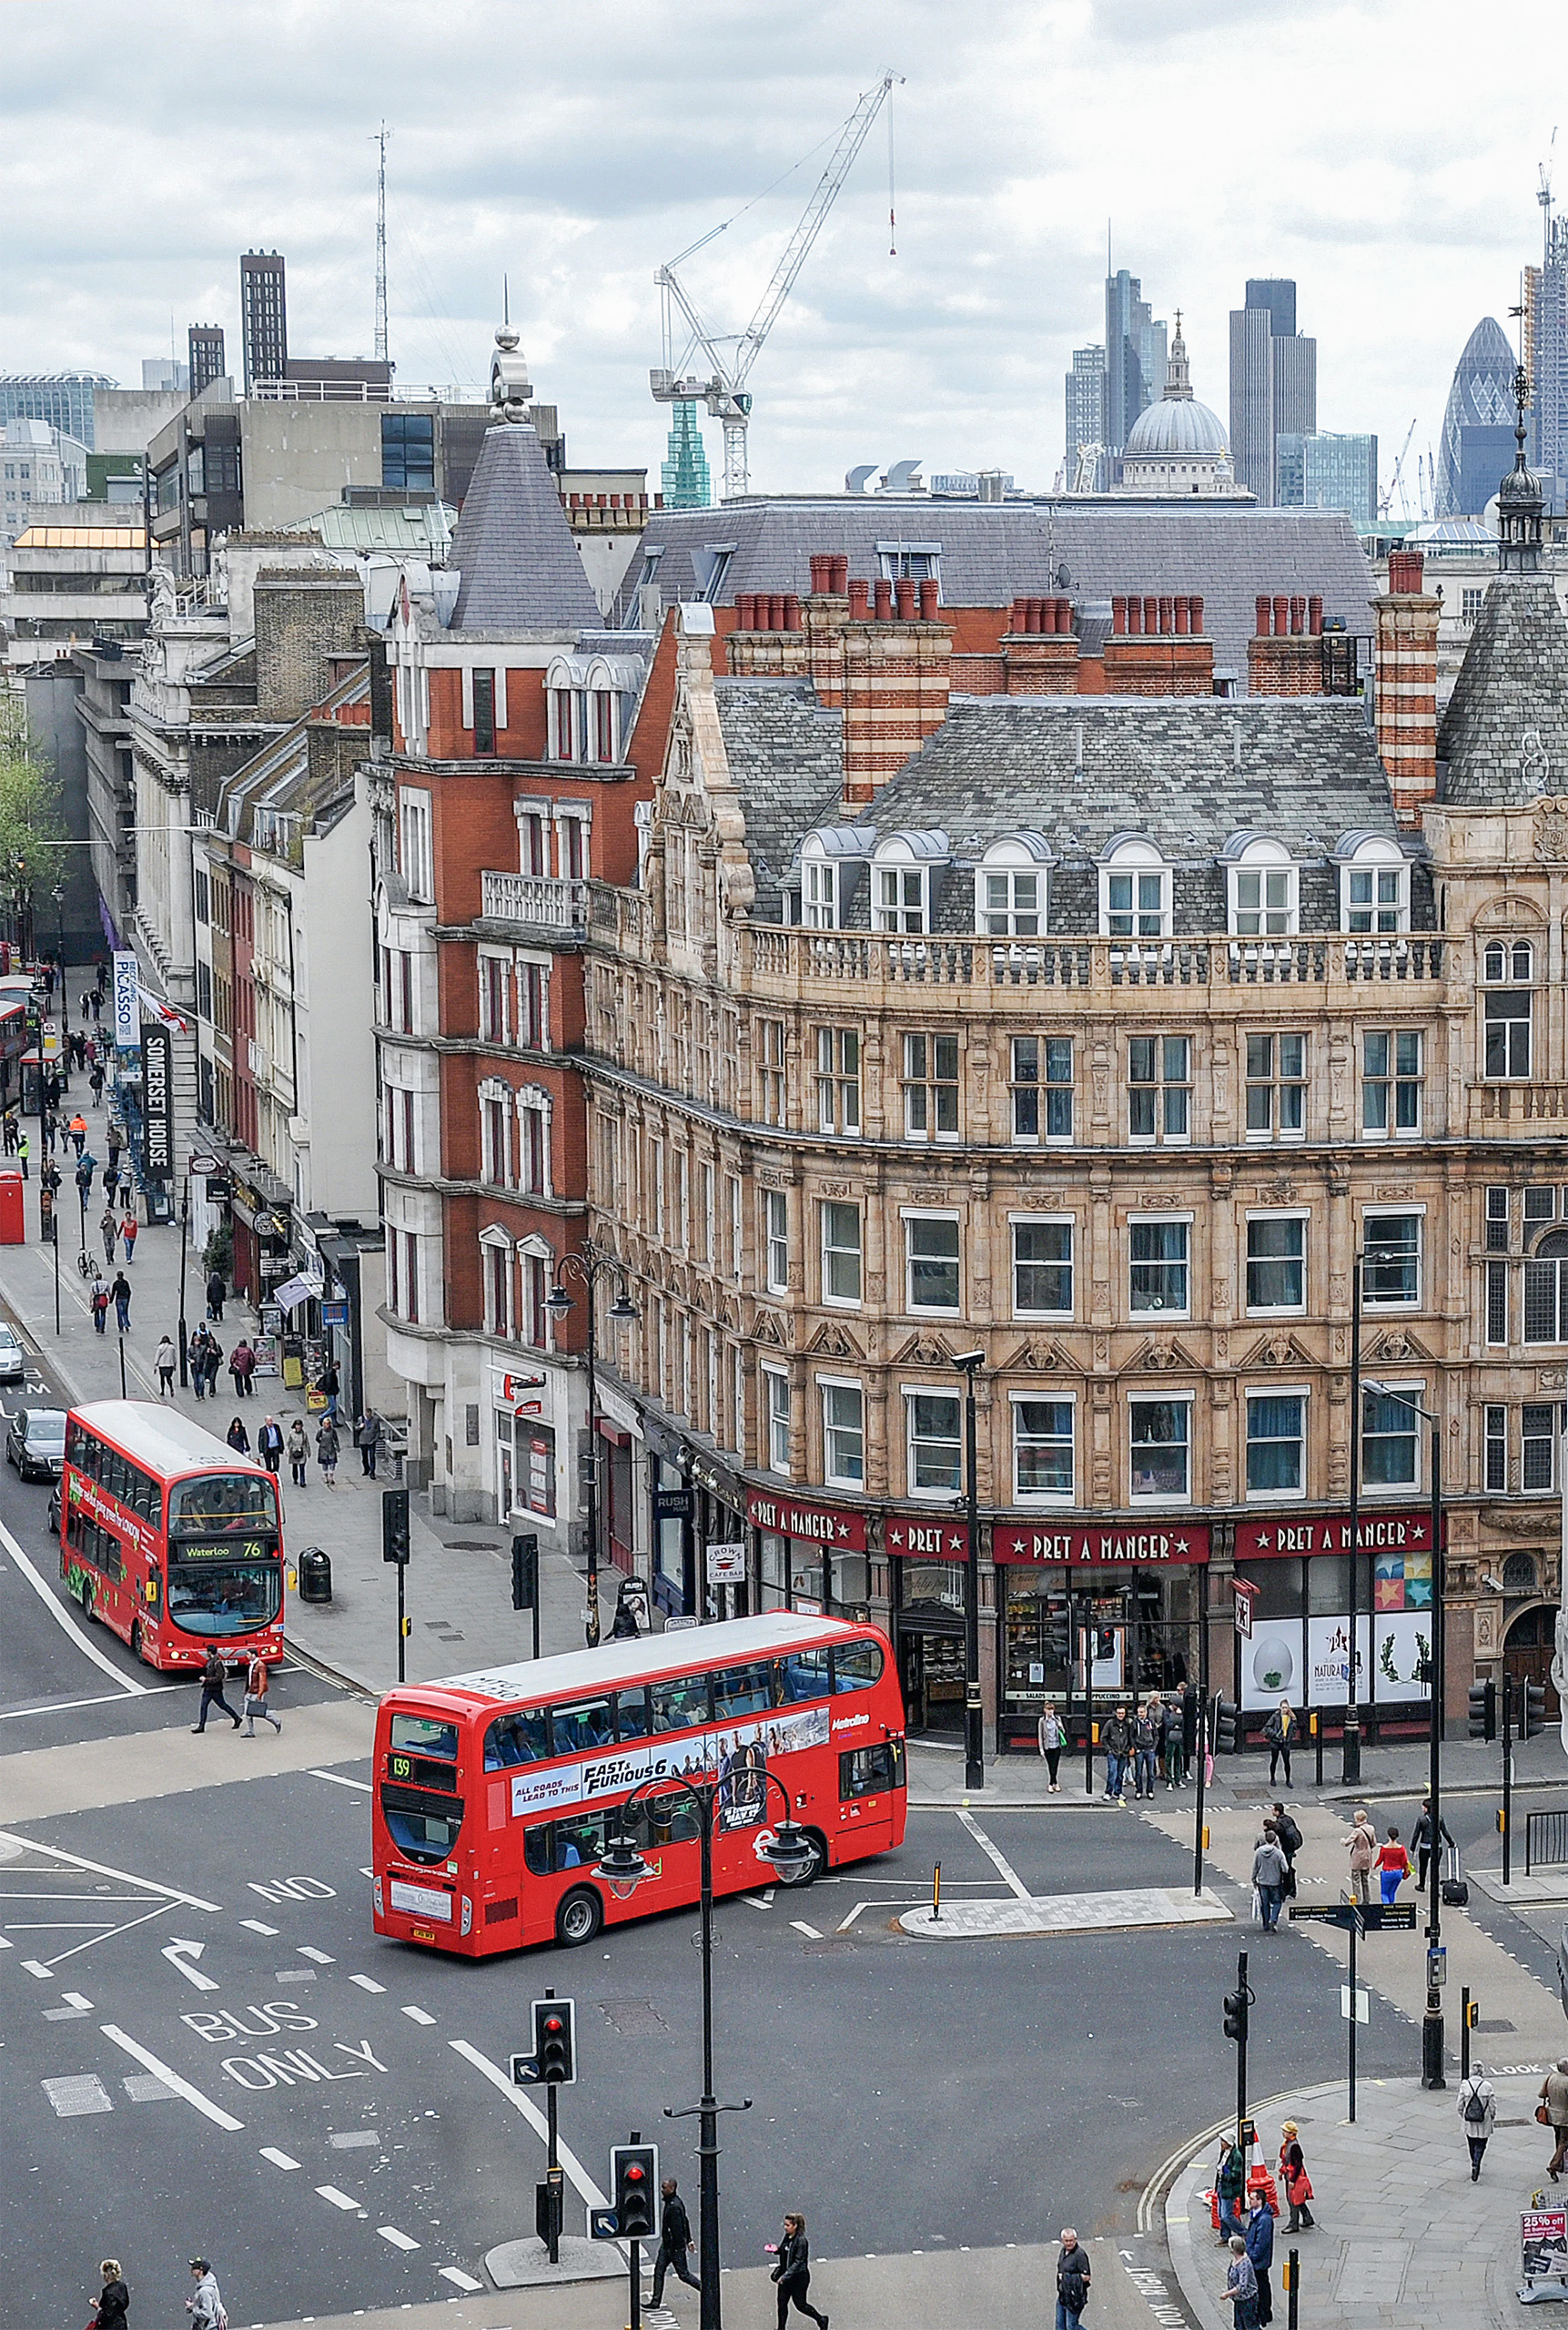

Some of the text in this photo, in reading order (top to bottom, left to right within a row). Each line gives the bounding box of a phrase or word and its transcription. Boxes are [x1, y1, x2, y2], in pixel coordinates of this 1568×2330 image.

[116, 961, 131, 1024] PICASSO
[147, 1037, 168, 1168] SOMERSET HOUSE
[658, 1496, 689, 1507] RUSH
[757, 1502, 835, 1540] PRET A MANGER
[908, 1527, 943, 1553] PRET
[1033, 1535, 1169, 1559] PRET A MANGER
[1277, 1522, 1406, 1551] PRET A MANGER
[186, 1543, 261, 1557] Waterloo 76
[709, 1547, 743, 1562] CROWN
[832, 1713, 870, 1731] Metroline
[394, 1758, 410, 1777] 139
[583, 1760, 631, 1783] FAST &
[587, 1758, 667, 1795] FURIOUS 6
[515, 1779, 563, 1797] ALL ROADS
[522, 1783, 580, 1803] LEAD TO THIS
[247, 1876, 337, 1904] NO
[180, 2001, 319, 2042] BUS
[220, 2040, 389, 2091] ONLY
[1490, 2063, 1543, 2075] LOOK
[1523, 2215, 1563, 2227] 25% off
[1124, 2266, 1169, 2295] RIGHT
[645, 2303, 681, 2330] OOK
